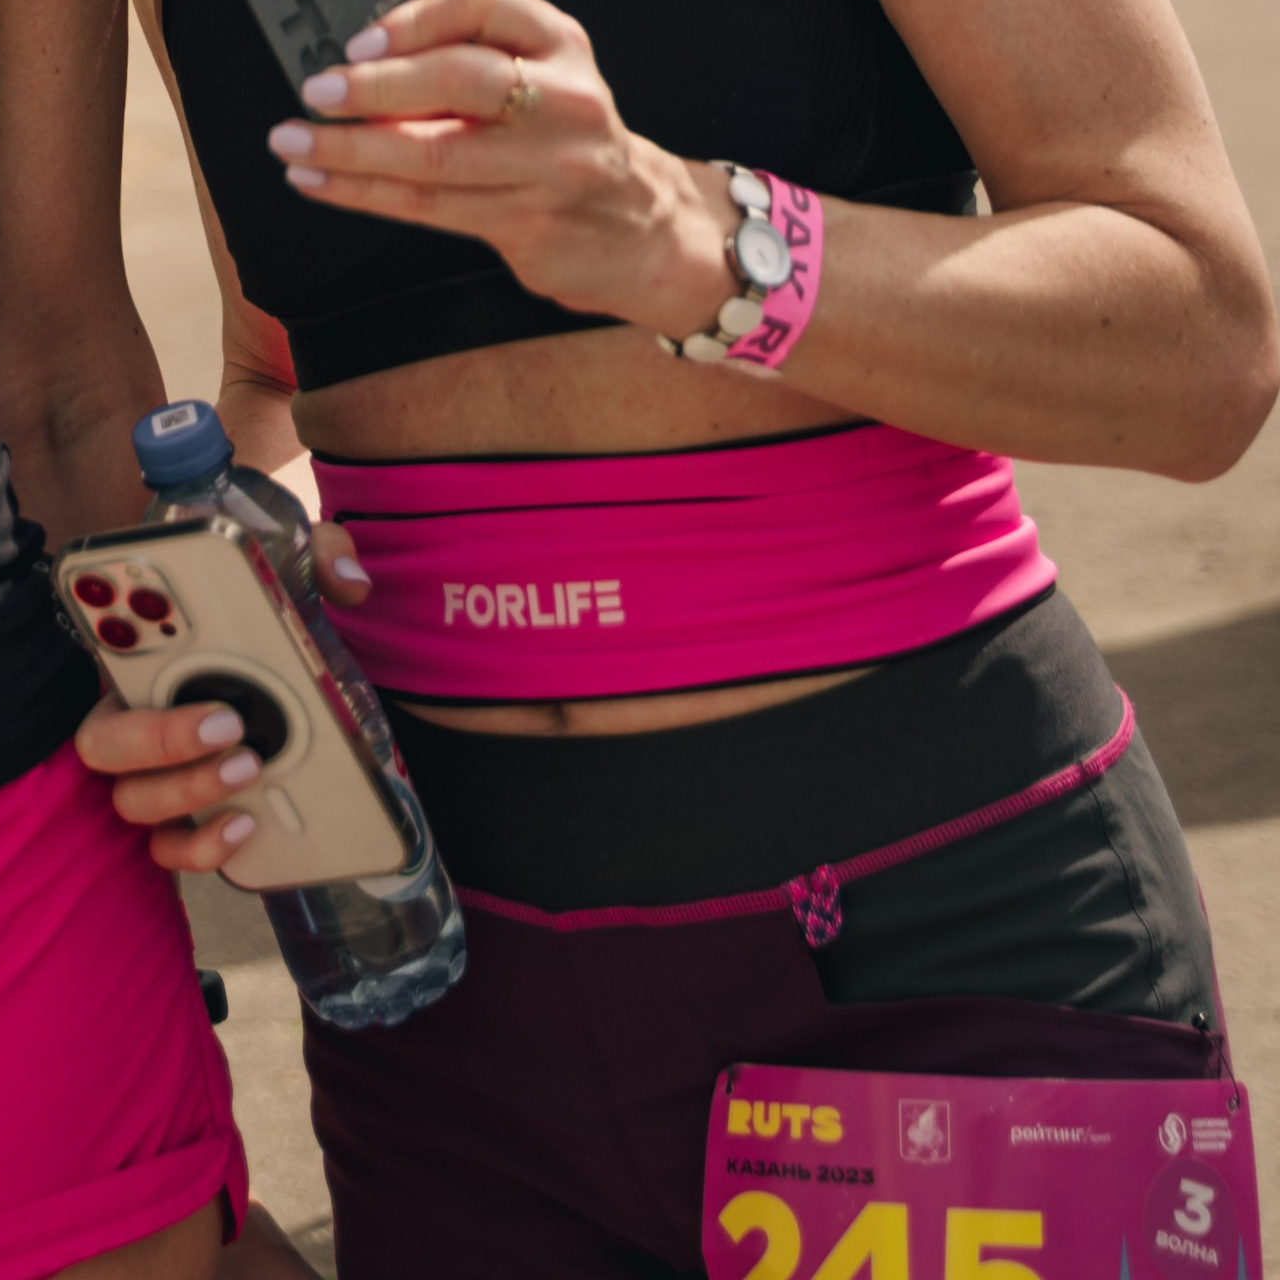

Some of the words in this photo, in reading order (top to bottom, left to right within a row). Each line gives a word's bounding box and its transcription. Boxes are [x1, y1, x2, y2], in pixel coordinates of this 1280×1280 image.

[443, 580, 624, 628] FORLIFE
[727, 1099, 843, 1143] RUTS
[726, 1158, 811, 1181] КАЗАНЬ
[817, 1165, 875, 1185] 2023
[1174, 1177, 1214, 1236] 3
[1155, 1229, 1220, 1267] ВОЛНА
